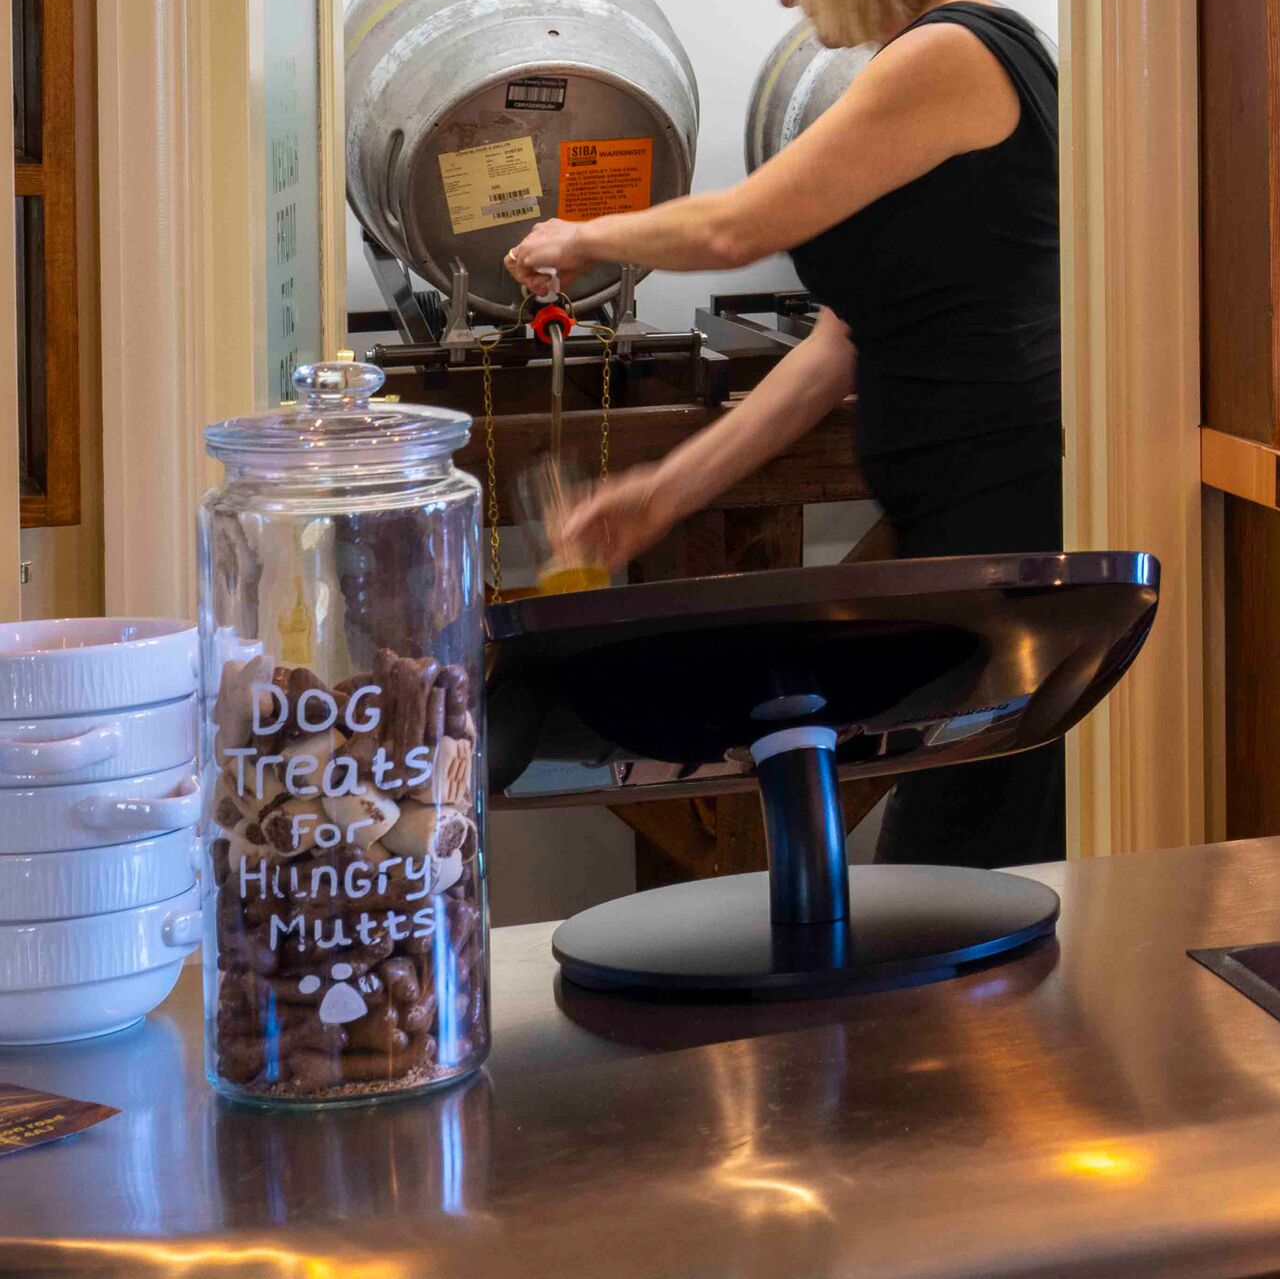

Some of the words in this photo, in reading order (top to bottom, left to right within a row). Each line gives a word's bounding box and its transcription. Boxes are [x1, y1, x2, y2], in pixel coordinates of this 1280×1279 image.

[572, 146, 597, 156] SIBA
[251, 682, 382, 736] DOG
[223, 745, 434, 800] Treats
[290, 813, 374, 849] For
[269, 906, 436, 953] Mutts
